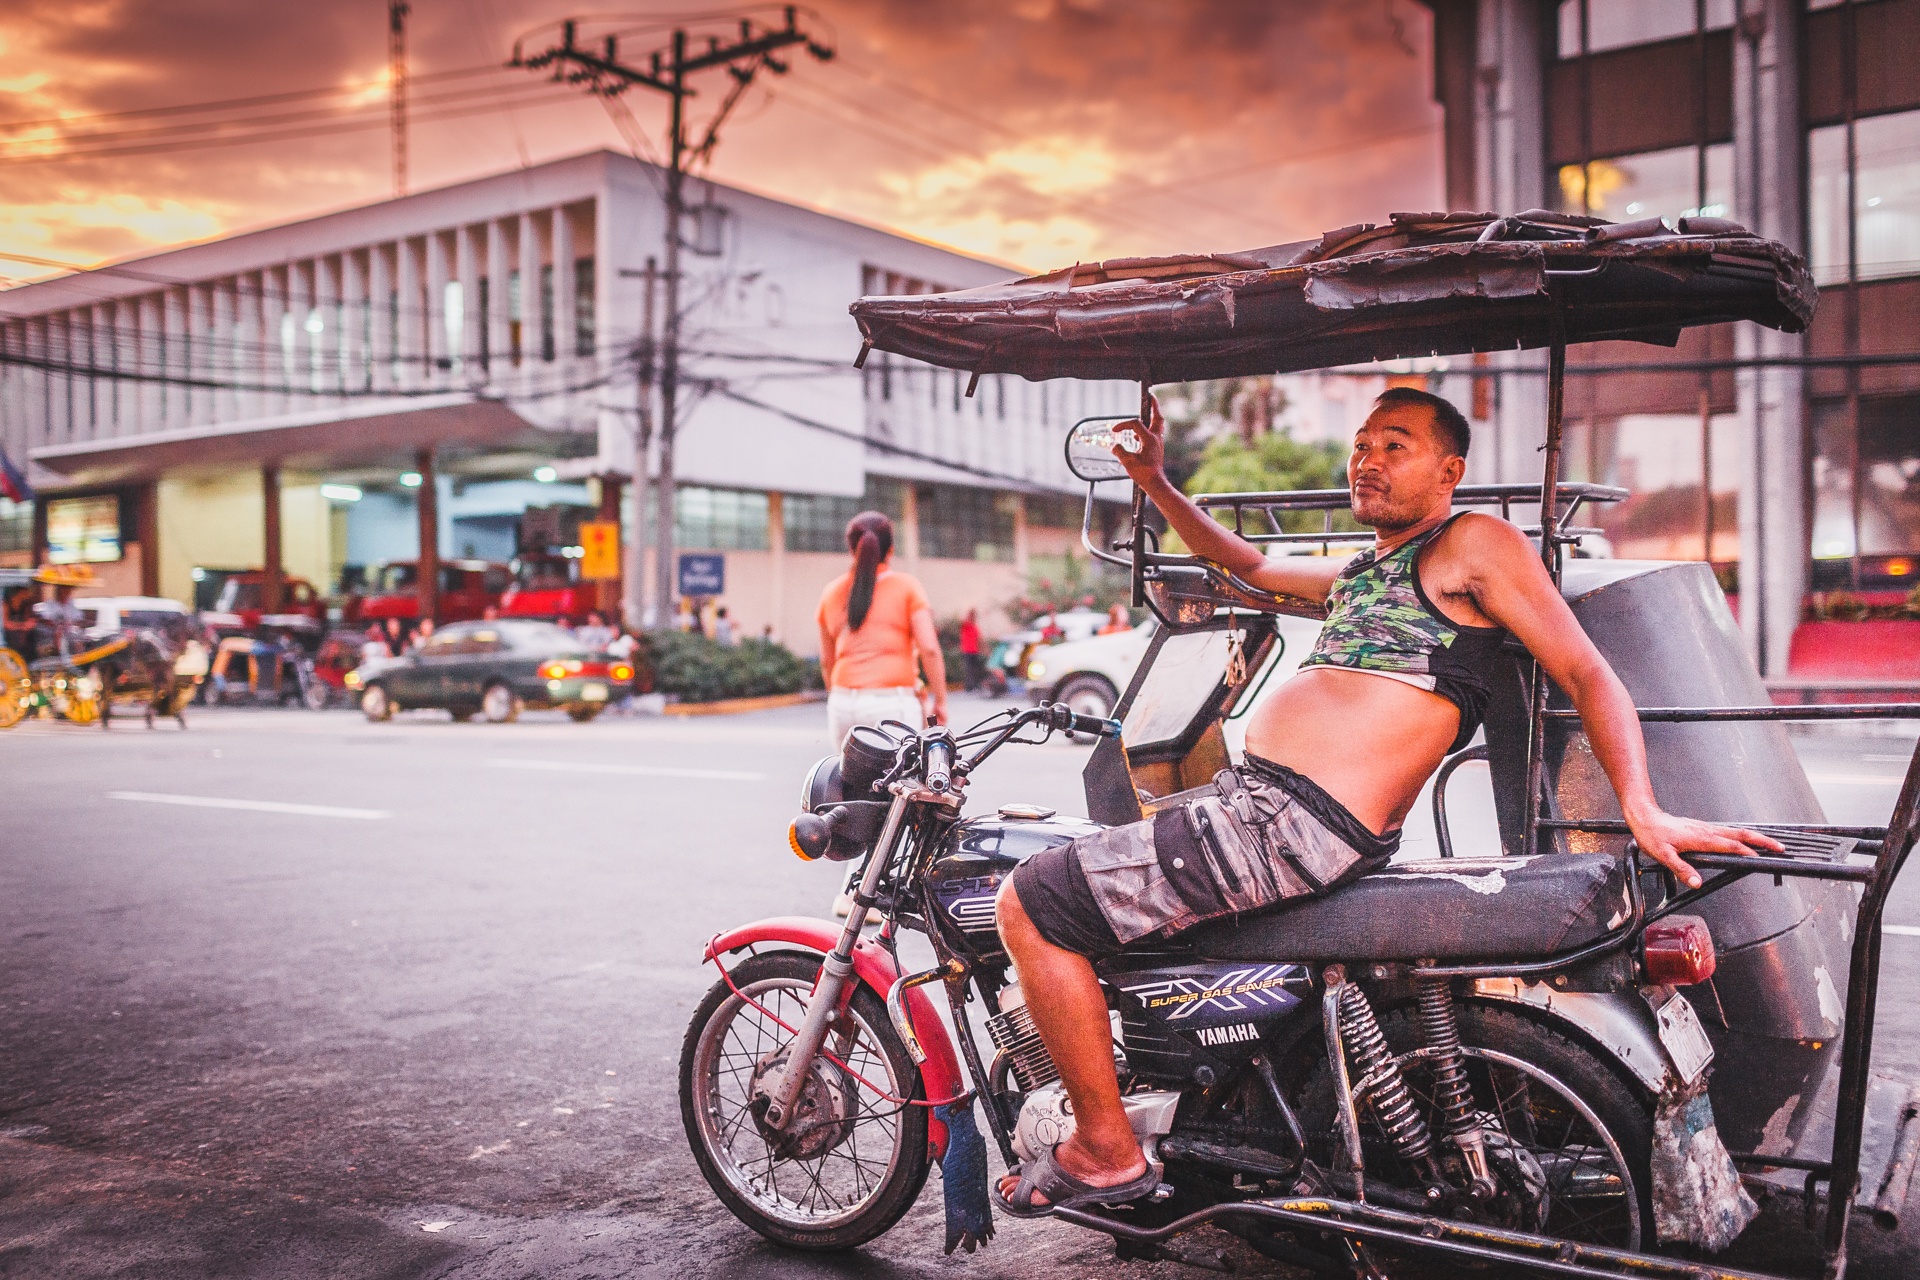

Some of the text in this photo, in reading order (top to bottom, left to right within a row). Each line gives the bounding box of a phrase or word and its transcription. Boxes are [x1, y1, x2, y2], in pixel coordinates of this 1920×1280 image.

[1149, 977, 1285, 1008] SUPER GAS SAVER
[1196, 1022, 1260, 1047] YAMAHA
